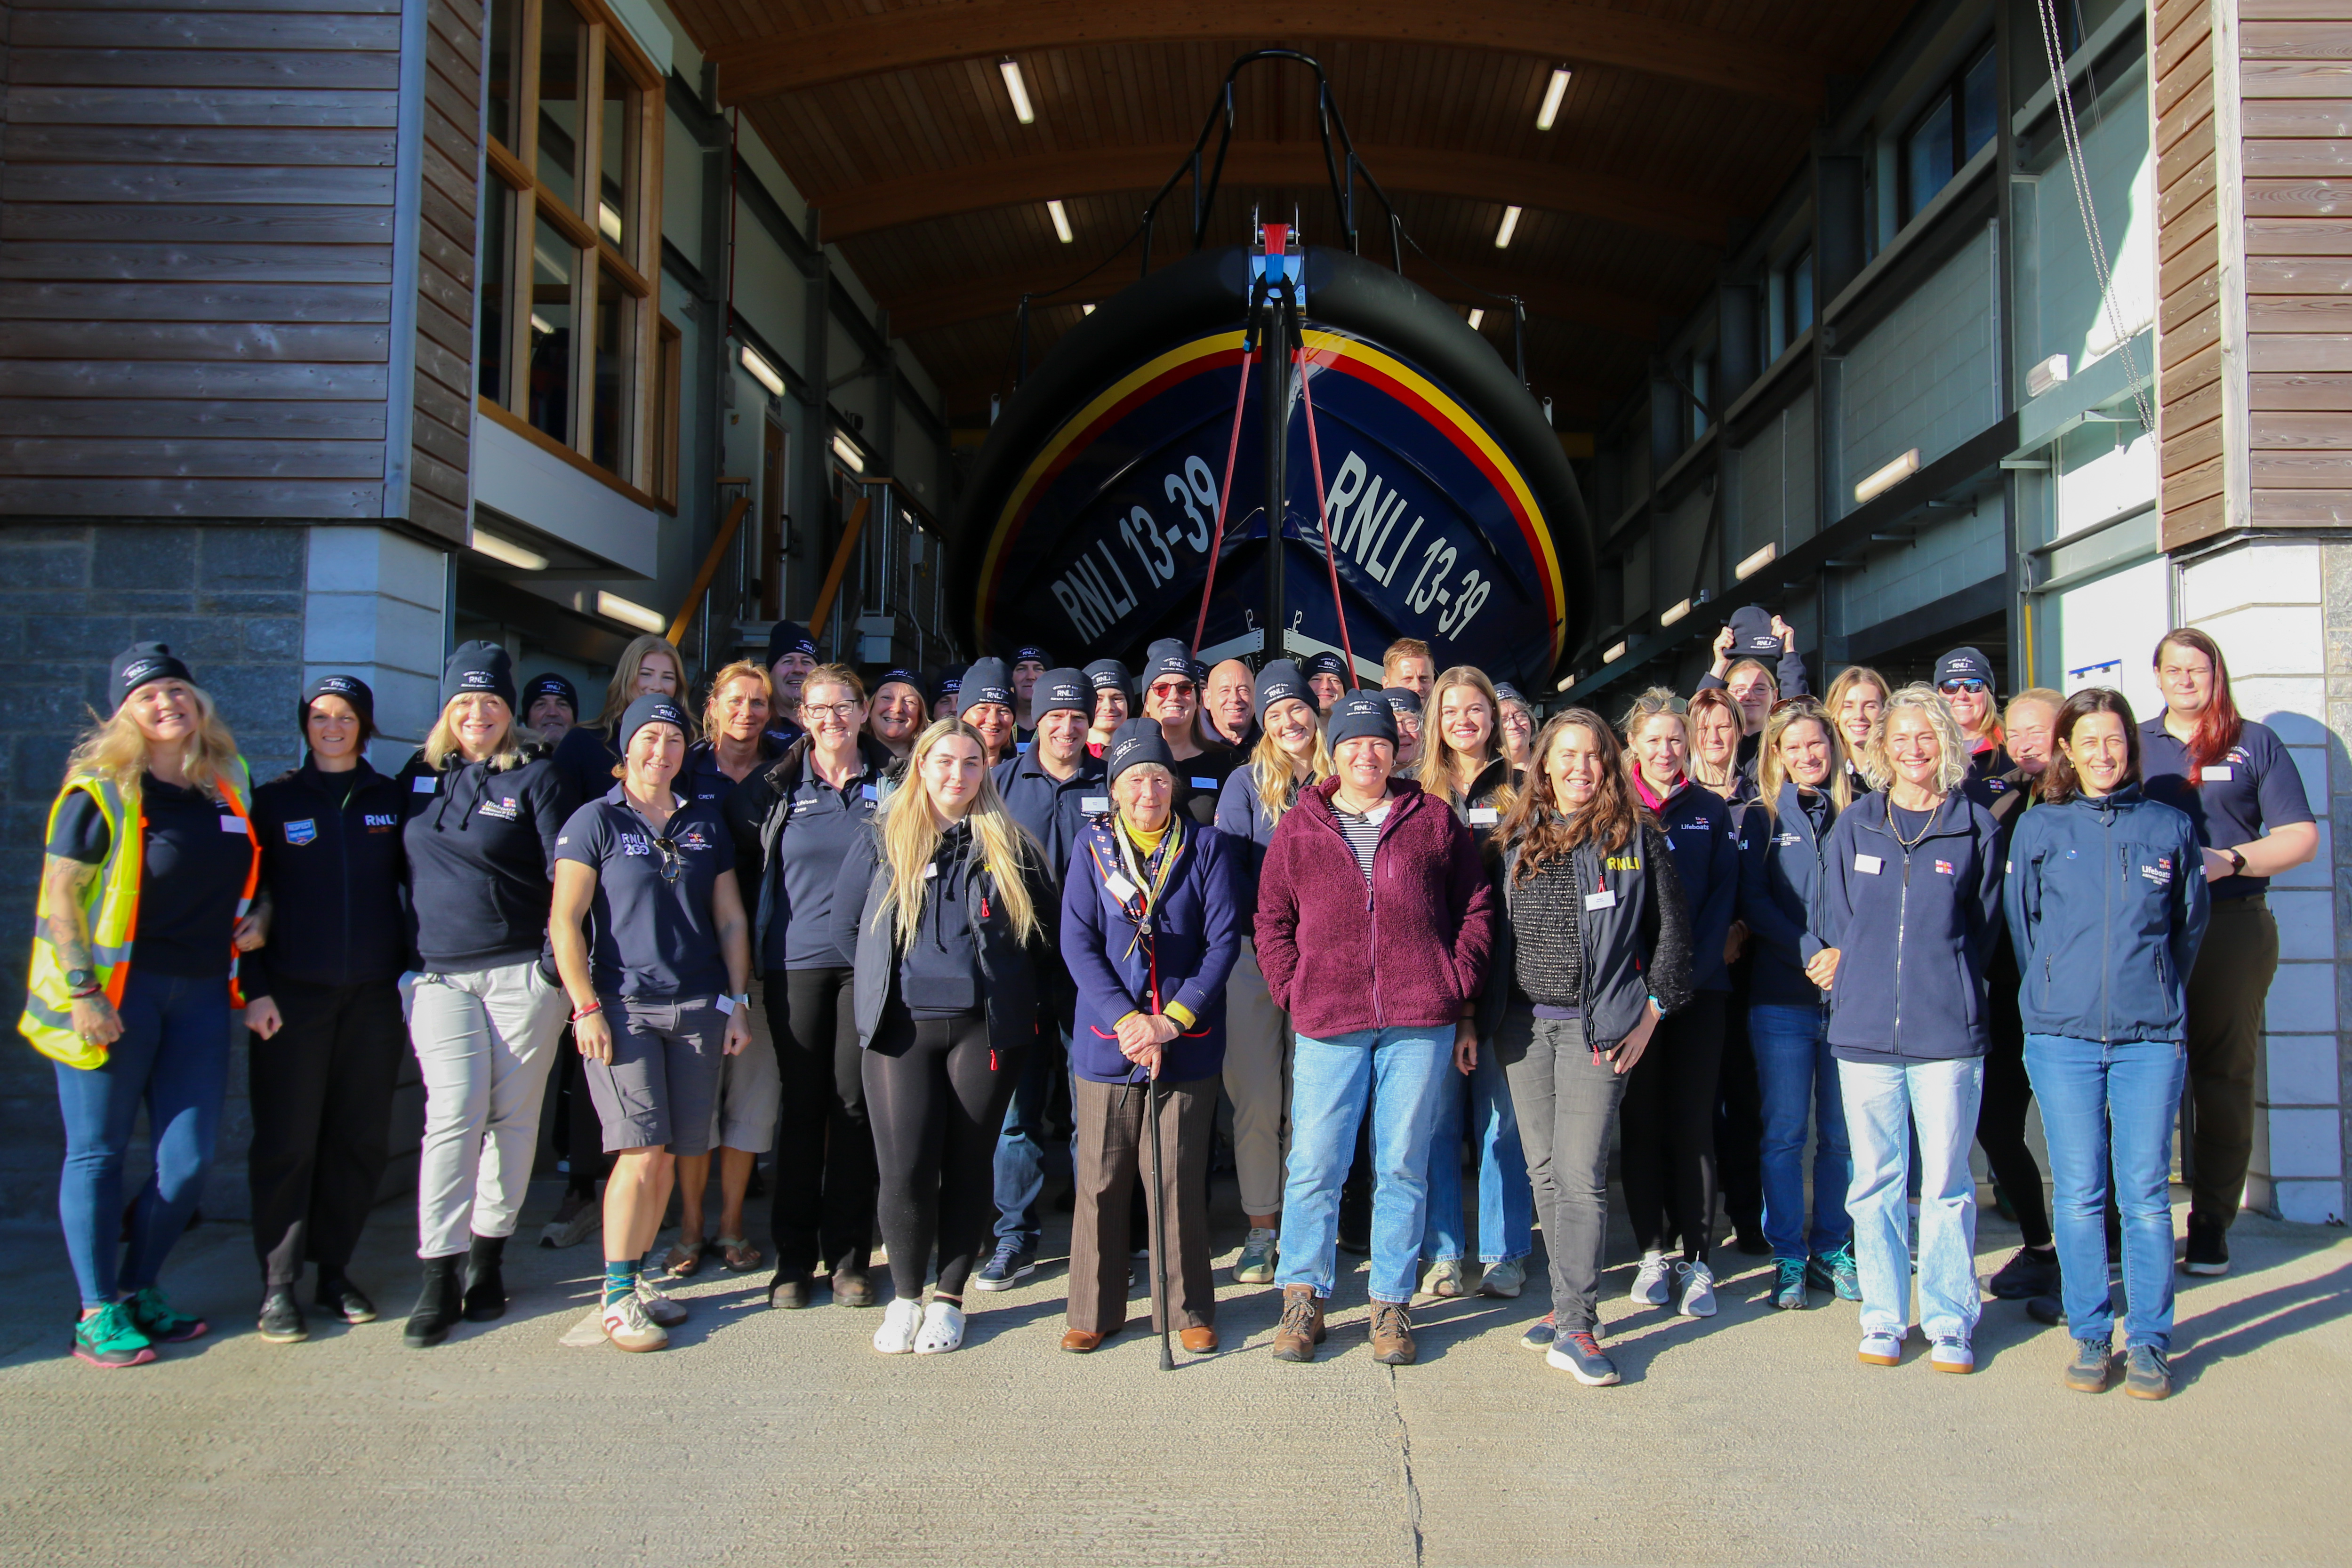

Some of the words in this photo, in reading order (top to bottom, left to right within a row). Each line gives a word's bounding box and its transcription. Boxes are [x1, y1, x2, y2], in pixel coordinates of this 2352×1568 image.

[1051, 539, 1138, 645] RNLI
[1118, 456, 1224, 589] 13-39
[1316, 450, 1425, 588] RNLI
[1405, 537, 1491, 641] 13-39
[803, 643, 815, 653] RNLI
[128, 664, 149, 679] RNLI
[1268, 688, 1284, 697] RNLI
[660, 709, 676, 718] RNLI
[1117, 742, 1131, 756] RNLI
[485, 800, 516, 811] Lifeboats
[865, 801, 877, 809] Life
[365, 815, 397, 825] RNLI
[621, 833, 648, 846] RNLI
[1606, 856, 1640, 871] RNLI
[2142, 865, 2171, 878] Lifeboats
